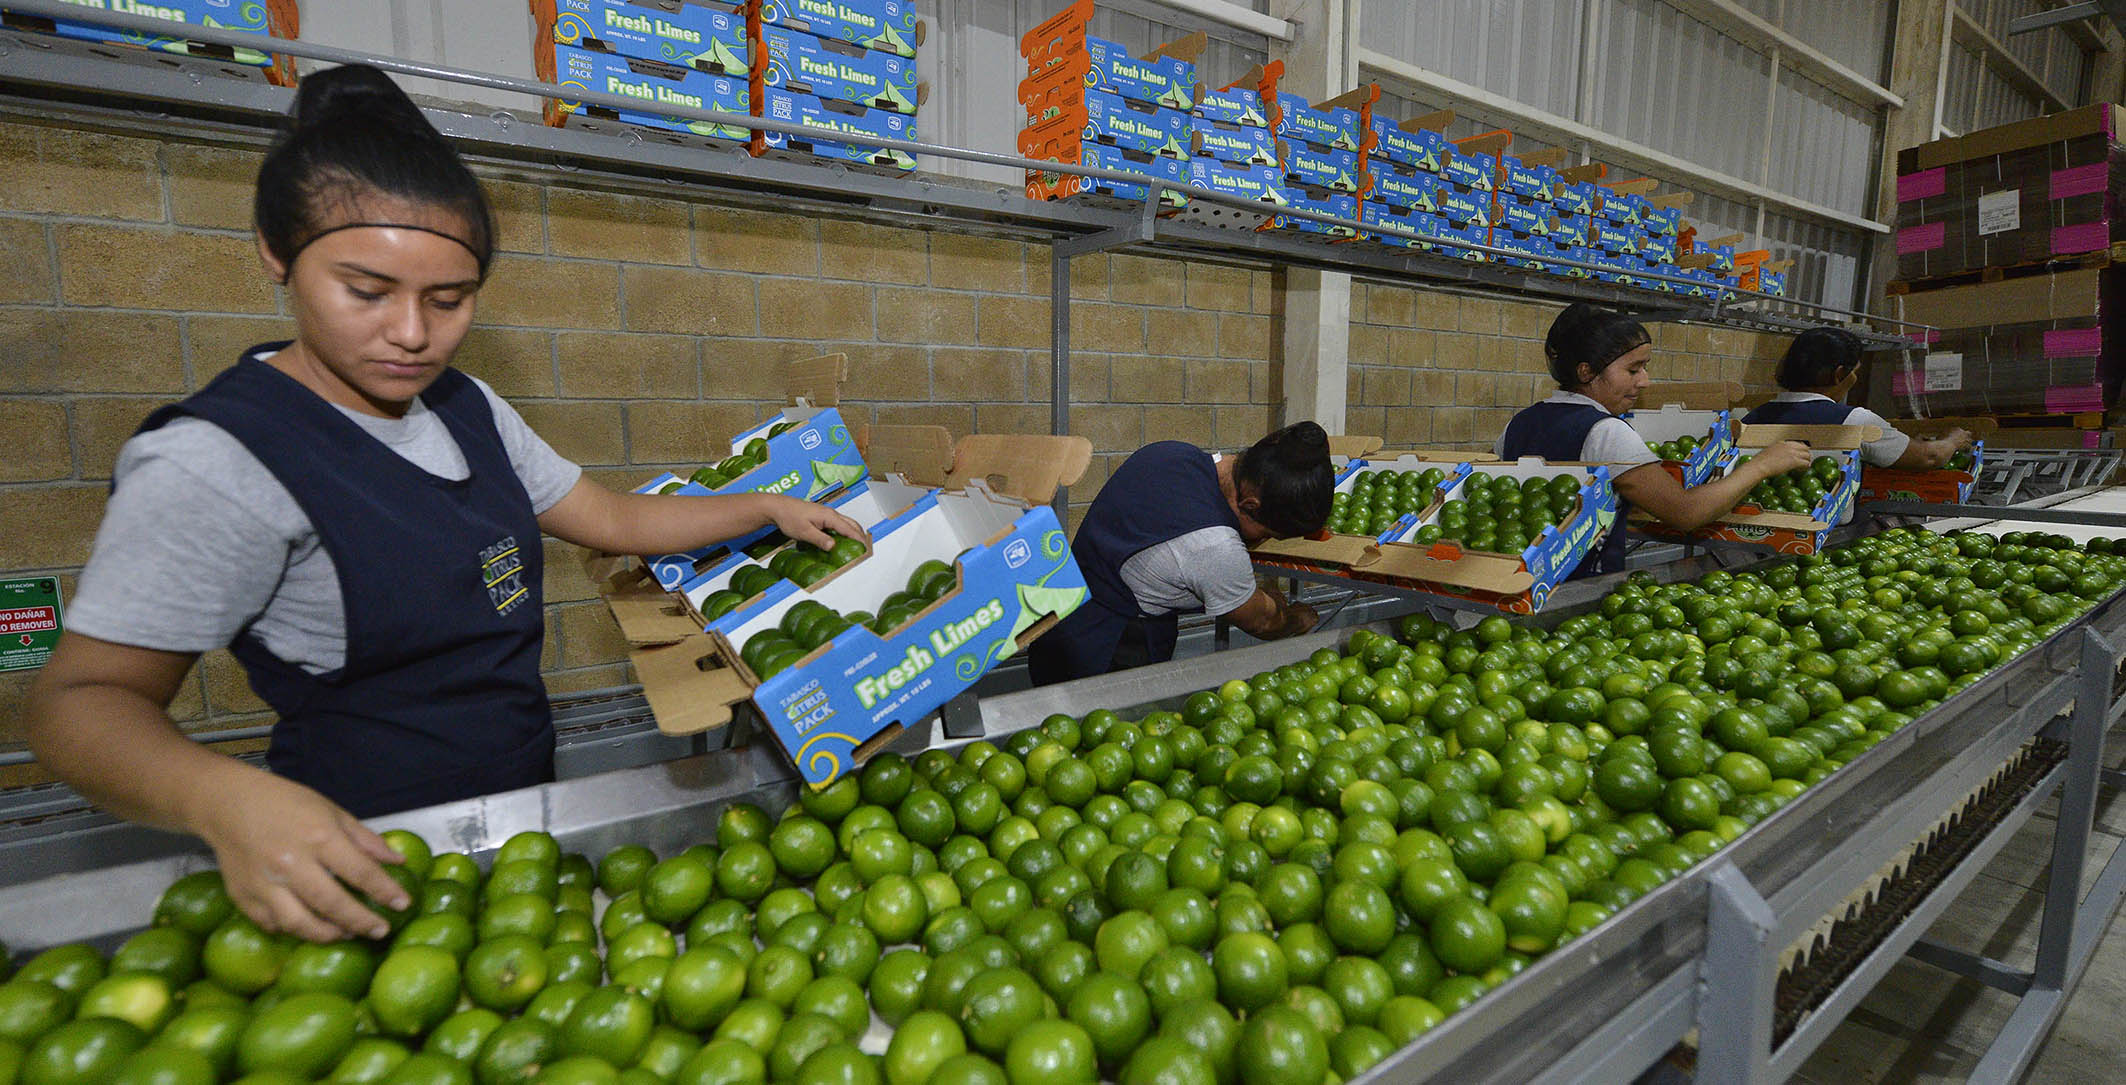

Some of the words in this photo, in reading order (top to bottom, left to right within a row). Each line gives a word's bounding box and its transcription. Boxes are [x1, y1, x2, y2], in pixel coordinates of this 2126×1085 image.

[605, 8, 652, 34] Fresh
[655, 19, 701, 44] Limes
[799, 0, 836, 18] Fresh
[839, 5, 876, 28] Limes
[568, 58, 592, 70] CITRUS
[568, 68, 592, 80] PACK
[800, 55, 838, 78] Fresh
[839, 64, 877, 87] Limes
[1112, 60, 1139, 79] Fresh
[1141, 68, 1167, 86] Limes
[606, 75, 654, 100] Fresh
[657, 85, 702, 109] Limes
[1217, 97, 1240, 110] Limes
[773, 108, 792, 120] PACK
[1296, 114, 1316, 128] Fresh
[1317, 119, 1338, 133] Limes
[1109, 115, 1135, 133] Fresh
[1137, 122, 1163, 140] Limes
[1202, 133, 1228, 147] Fresh
[1228, 137, 1252, 150] Limes
[1387, 134, 1405, 148] Fresh
[1405, 139, 1424, 153] Limes
[1296, 156, 1316, 170] Fresh
[1317, 160, 1337, 175] Limes
[1212, 174, 1236, 188] Fresh
[1237, 177, 1261, 190] Limes
[1382, 178, 1400, 192] Fresh
[1401, 183, 1419, 196] Limes
[757, 470, 801, 494] mes
[1551, 537, 1573, 571] Fresh
[1571, 514, 1593, 547] Limes
[488, 572, 524, 608] PACK
[0, 612, 12, 621] NO
[14, 609, 46, 620] DAÑAR
[0, 623, 8, 632] O
[10, 619, 54, 631] REMOVER
[854, 644, 935, 710] Fresh
[929, 597, 1005, 659] Limes
[780, 679, 819, 708] TABASCO
[786, 689, 828, 720] CITRUS
[794, 702, 834, 735] PACK
